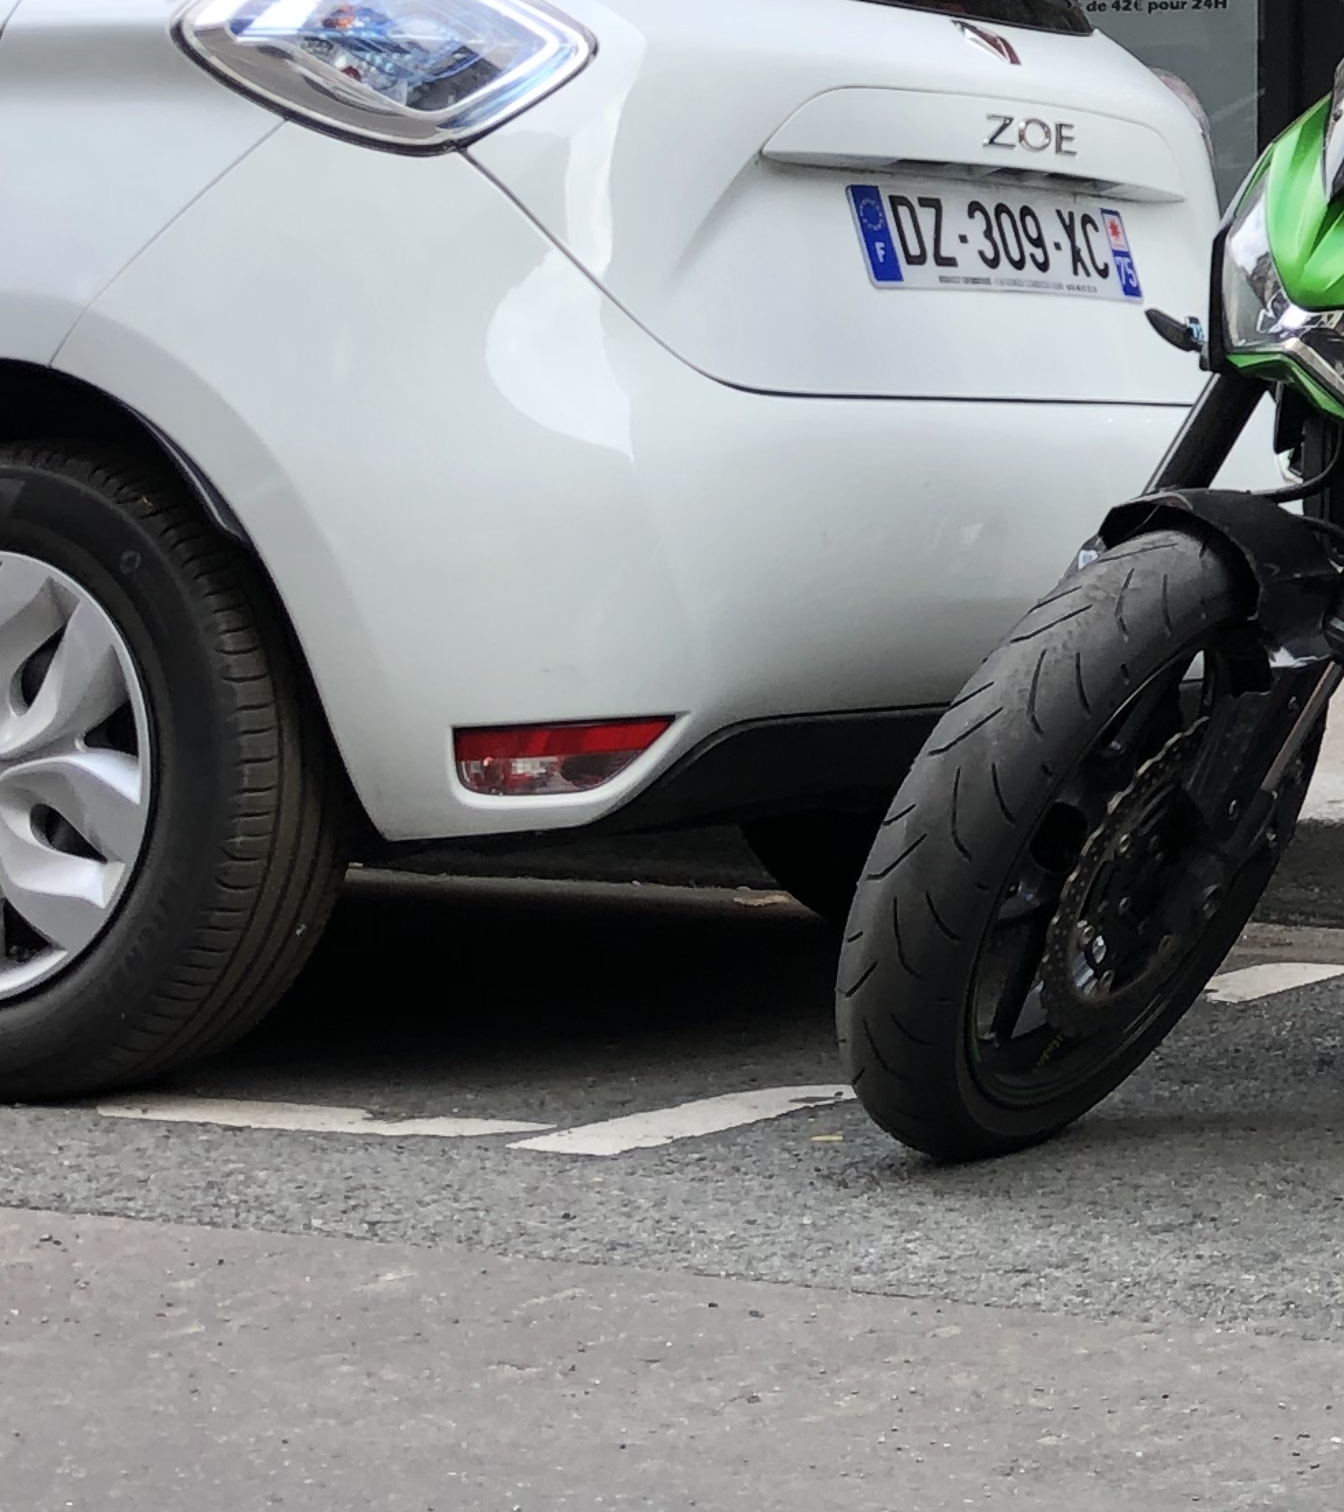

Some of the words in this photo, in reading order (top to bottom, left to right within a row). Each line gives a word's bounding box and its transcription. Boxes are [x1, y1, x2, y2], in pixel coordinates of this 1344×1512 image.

[1086, 0, 1107, 13] de
[1148, 0, 1188, 15] pour
[982, 112, 1079, 157] ZOE
[873, 241, 886, 265] F
[887, 194, 1111, 280] DZ-309-XC
[1115, 255, 1138, 288] 75
